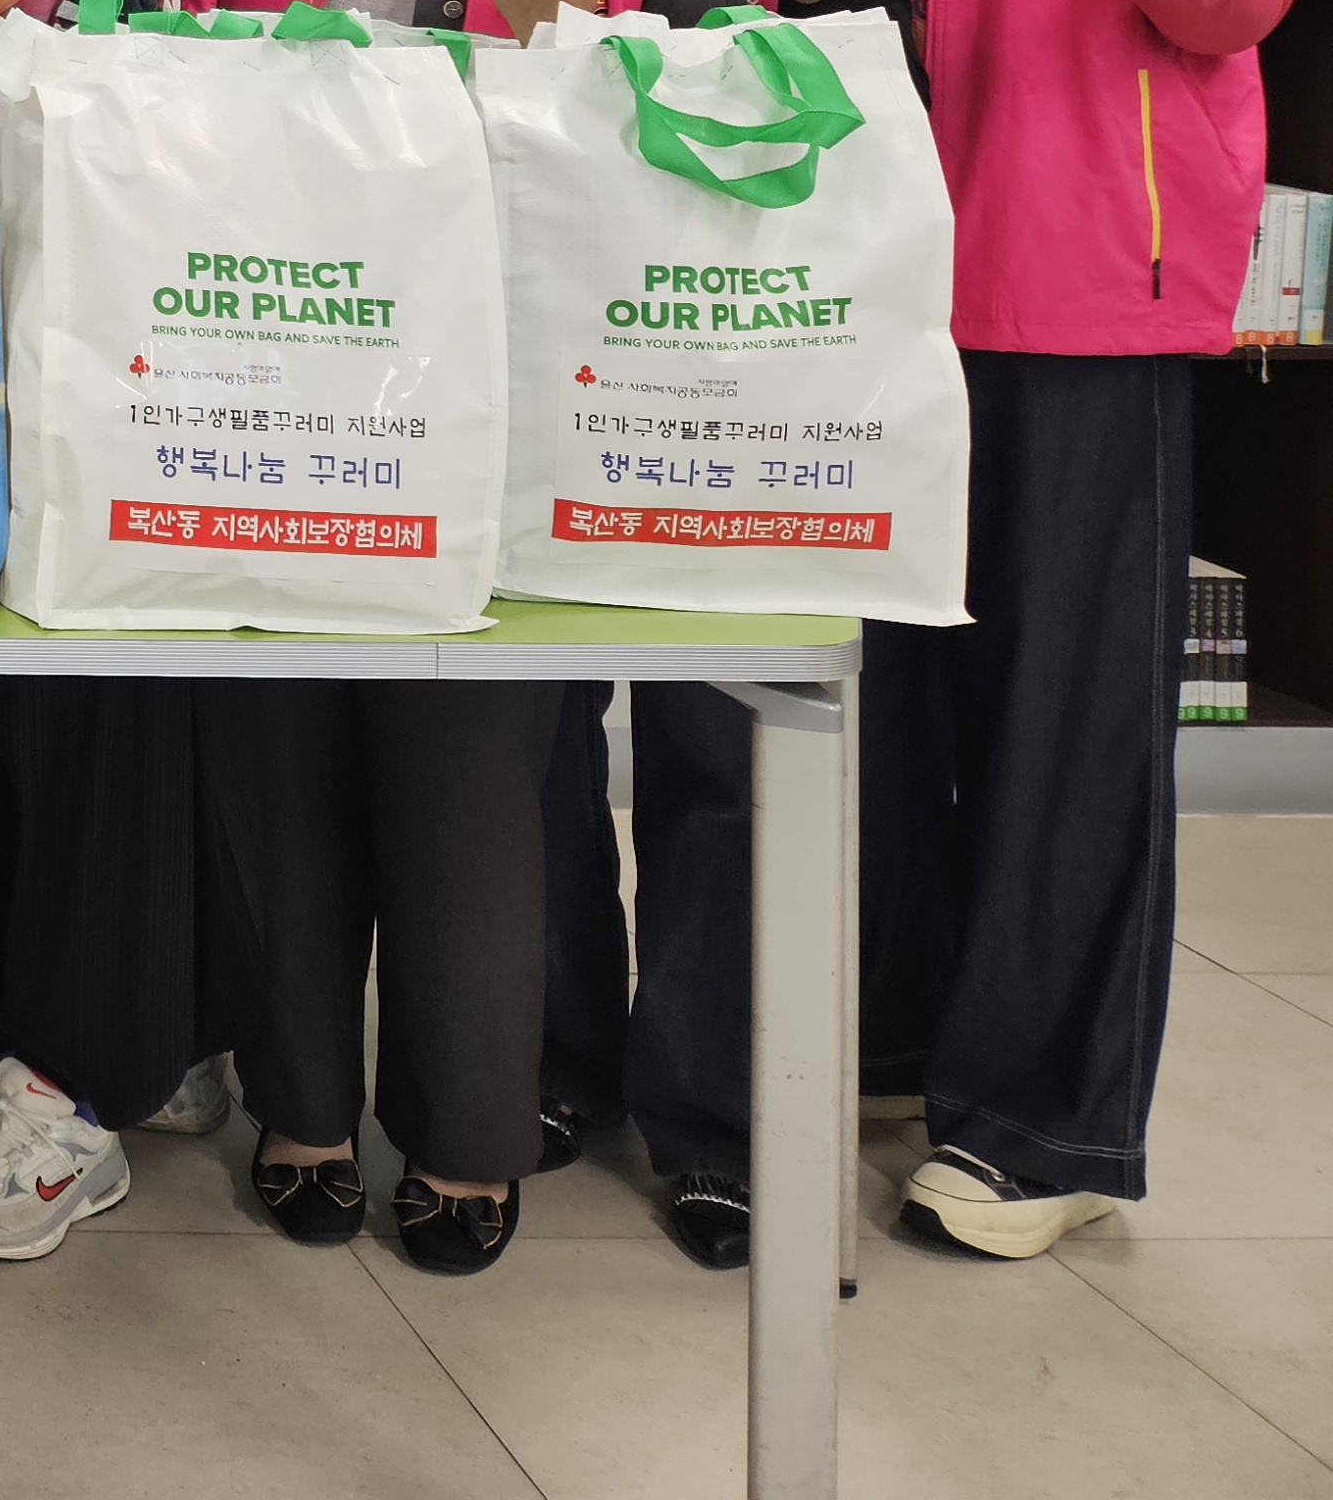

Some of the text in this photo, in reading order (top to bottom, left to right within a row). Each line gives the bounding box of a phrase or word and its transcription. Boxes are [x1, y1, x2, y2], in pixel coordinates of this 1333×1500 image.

[187, 251, 365, 289] PROTECT
[644, 264, 811, 295] PROTECT
[152, 286, 396, 328] OUR PLANET
[605, 297, 852, 331] OUR PLANET
[151, 325, 400, 348] BRING YOUR OWN BAG AND SAVE THE EARTH
[603, 335, 857, 351] BRING YOUR OWN BAG AND SAVE THE EARTH
[129, 404, 426, 438] 1인가구생필품꾸러미 지원사업
[573, 412, 883, 442] 1인가구생필품꾸러미 지원사업
[156, 445, 401, 489] 행복나눔 꾸러미
[601, 451, 854, 489] 행복나눔 꾸러미
[128, 506, 423, 550] 복산동 지역사회보장협의체
[569, 506, 875, 544] 복산동 지역사회보장협의체
[1188, 708, 1196, 718] 9
